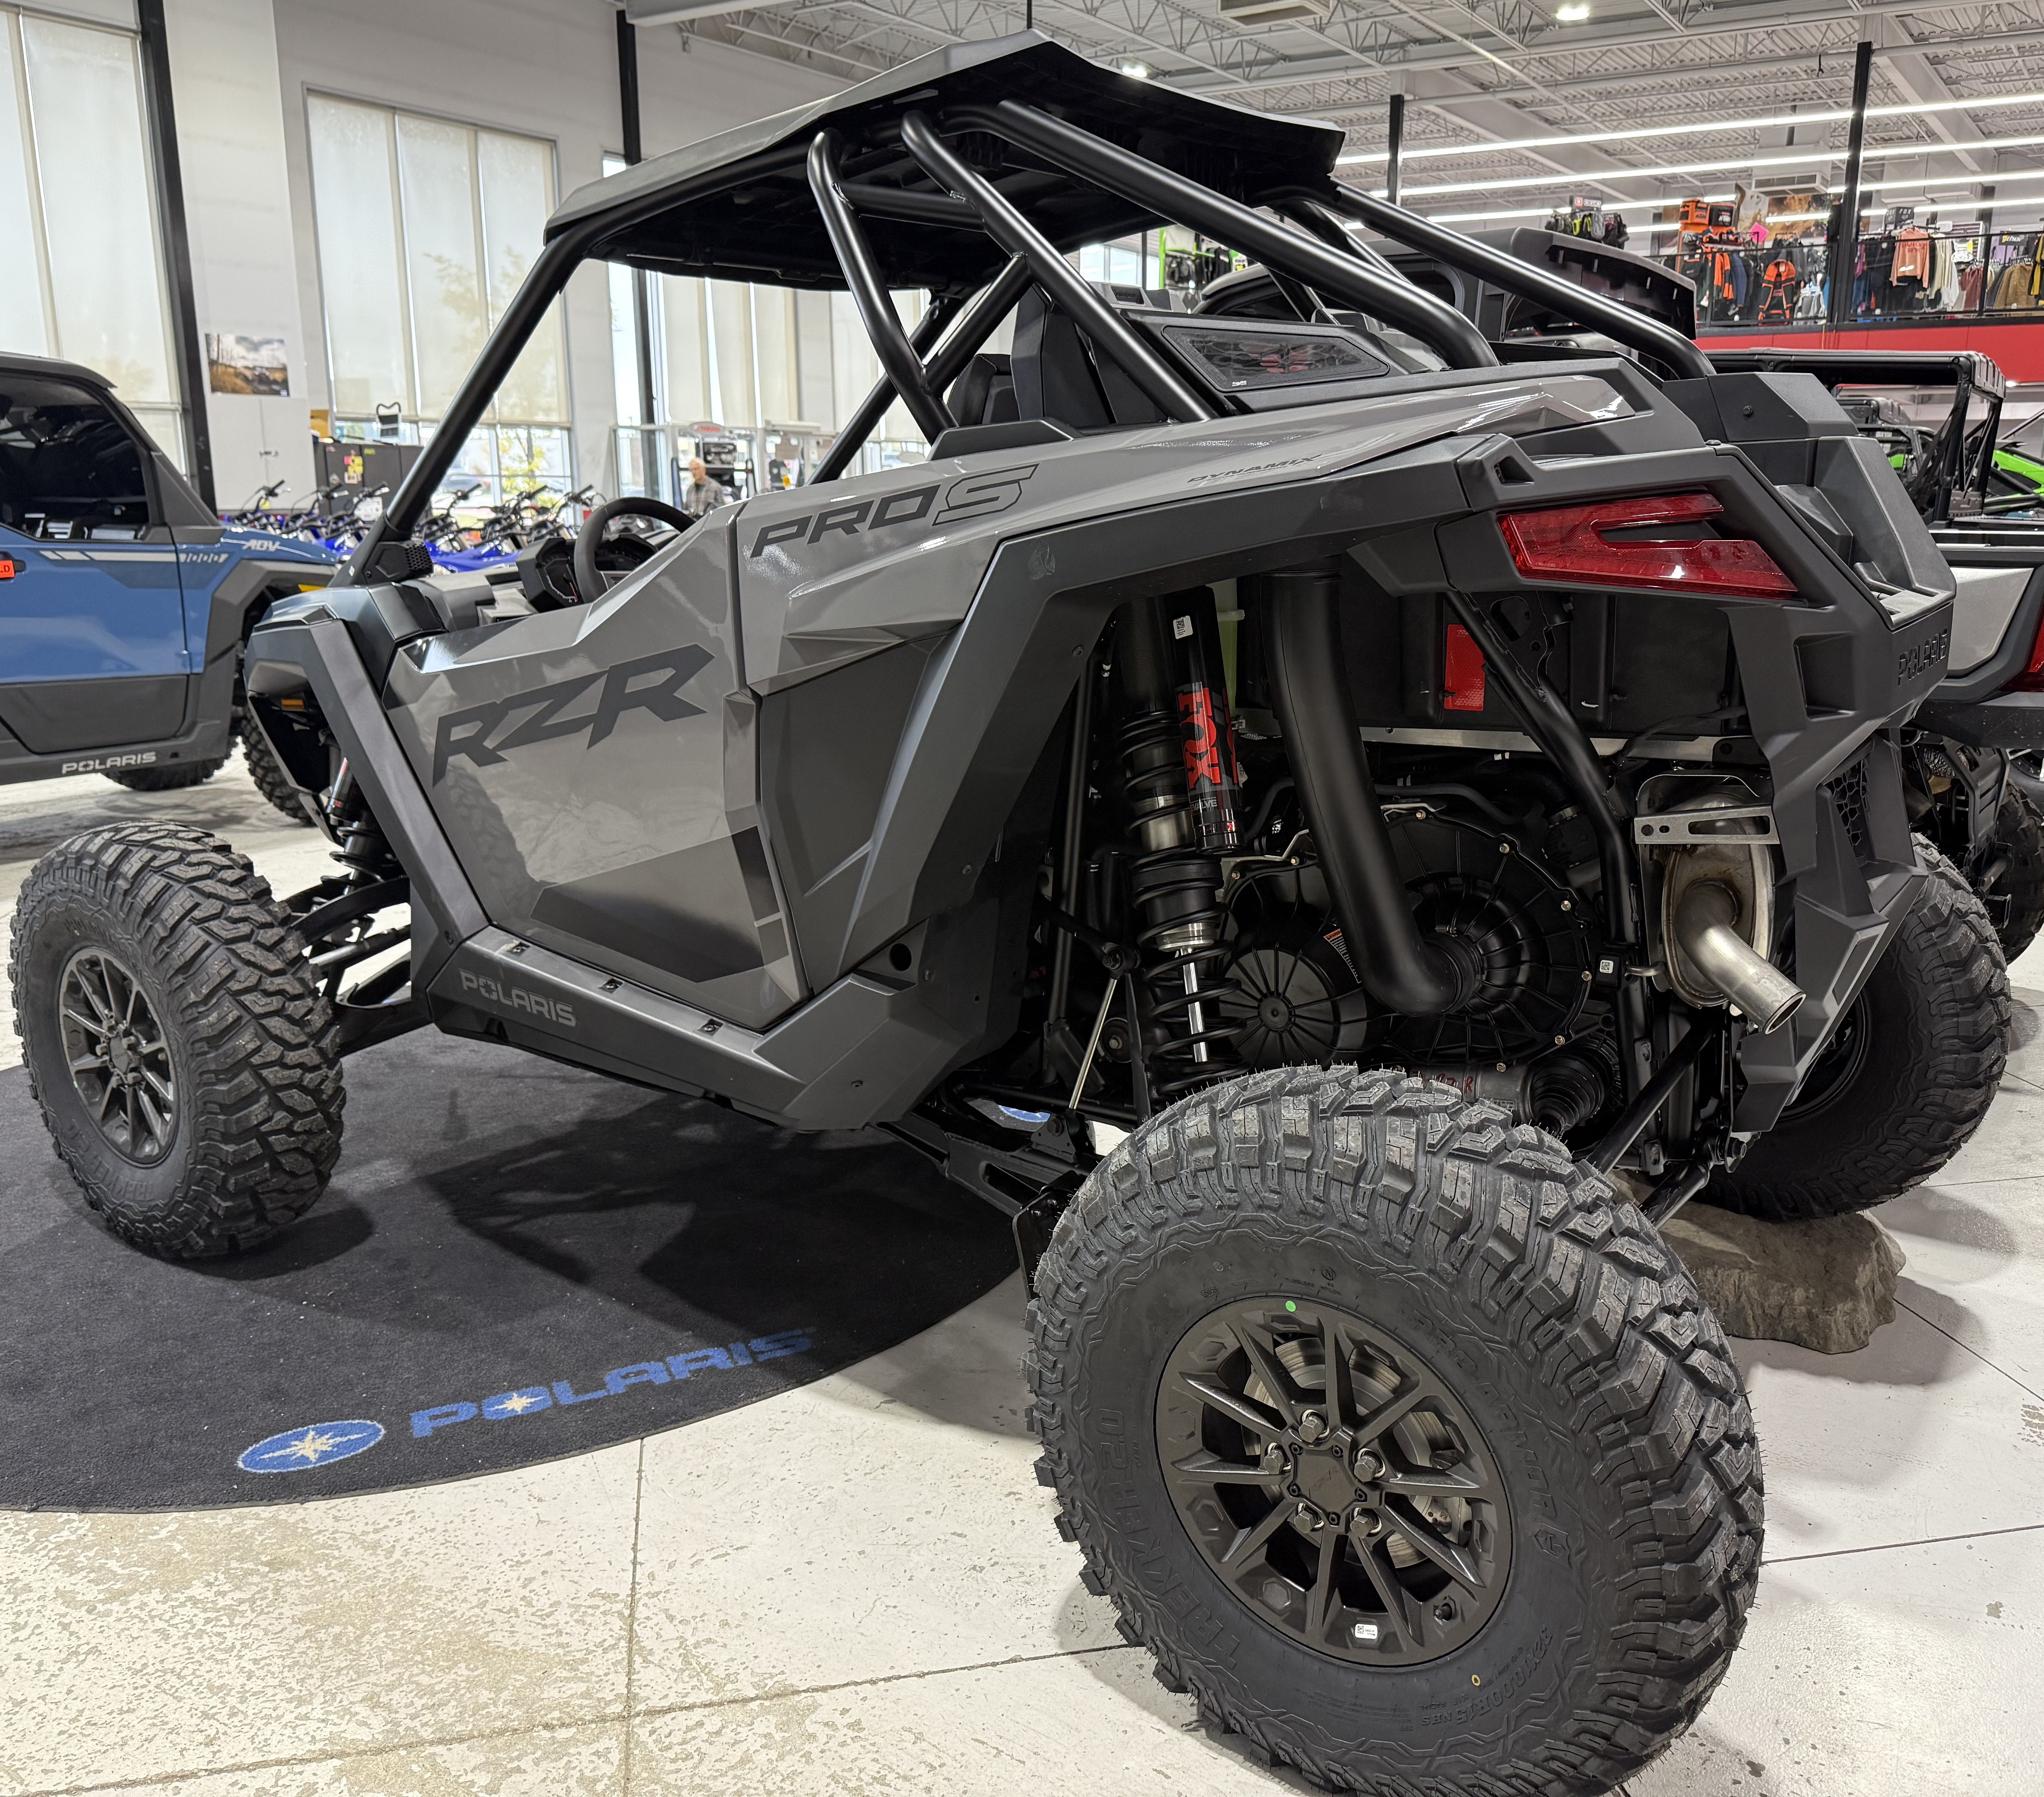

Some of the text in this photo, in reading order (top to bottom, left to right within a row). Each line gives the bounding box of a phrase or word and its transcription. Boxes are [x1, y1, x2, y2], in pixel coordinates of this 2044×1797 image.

[1187, 454, 1322, 483] DYNAMIX
[242, 539, 280, 552] ADV
[1898, 629, 1948, 686] POLARIS
[432, 643, 716, 789] RZR
[1178, 687, 1222, 790] FOX
[61, 751, 157, 775] POLARIS
[460, 969, 576, 1028] POLARIS
[411, 1329, 813, 1438] POLARIS
[1476, 1381, 1557, 1517] ARMOR
[1098, 1408, 1241, 1670] TREKKER 2.0
